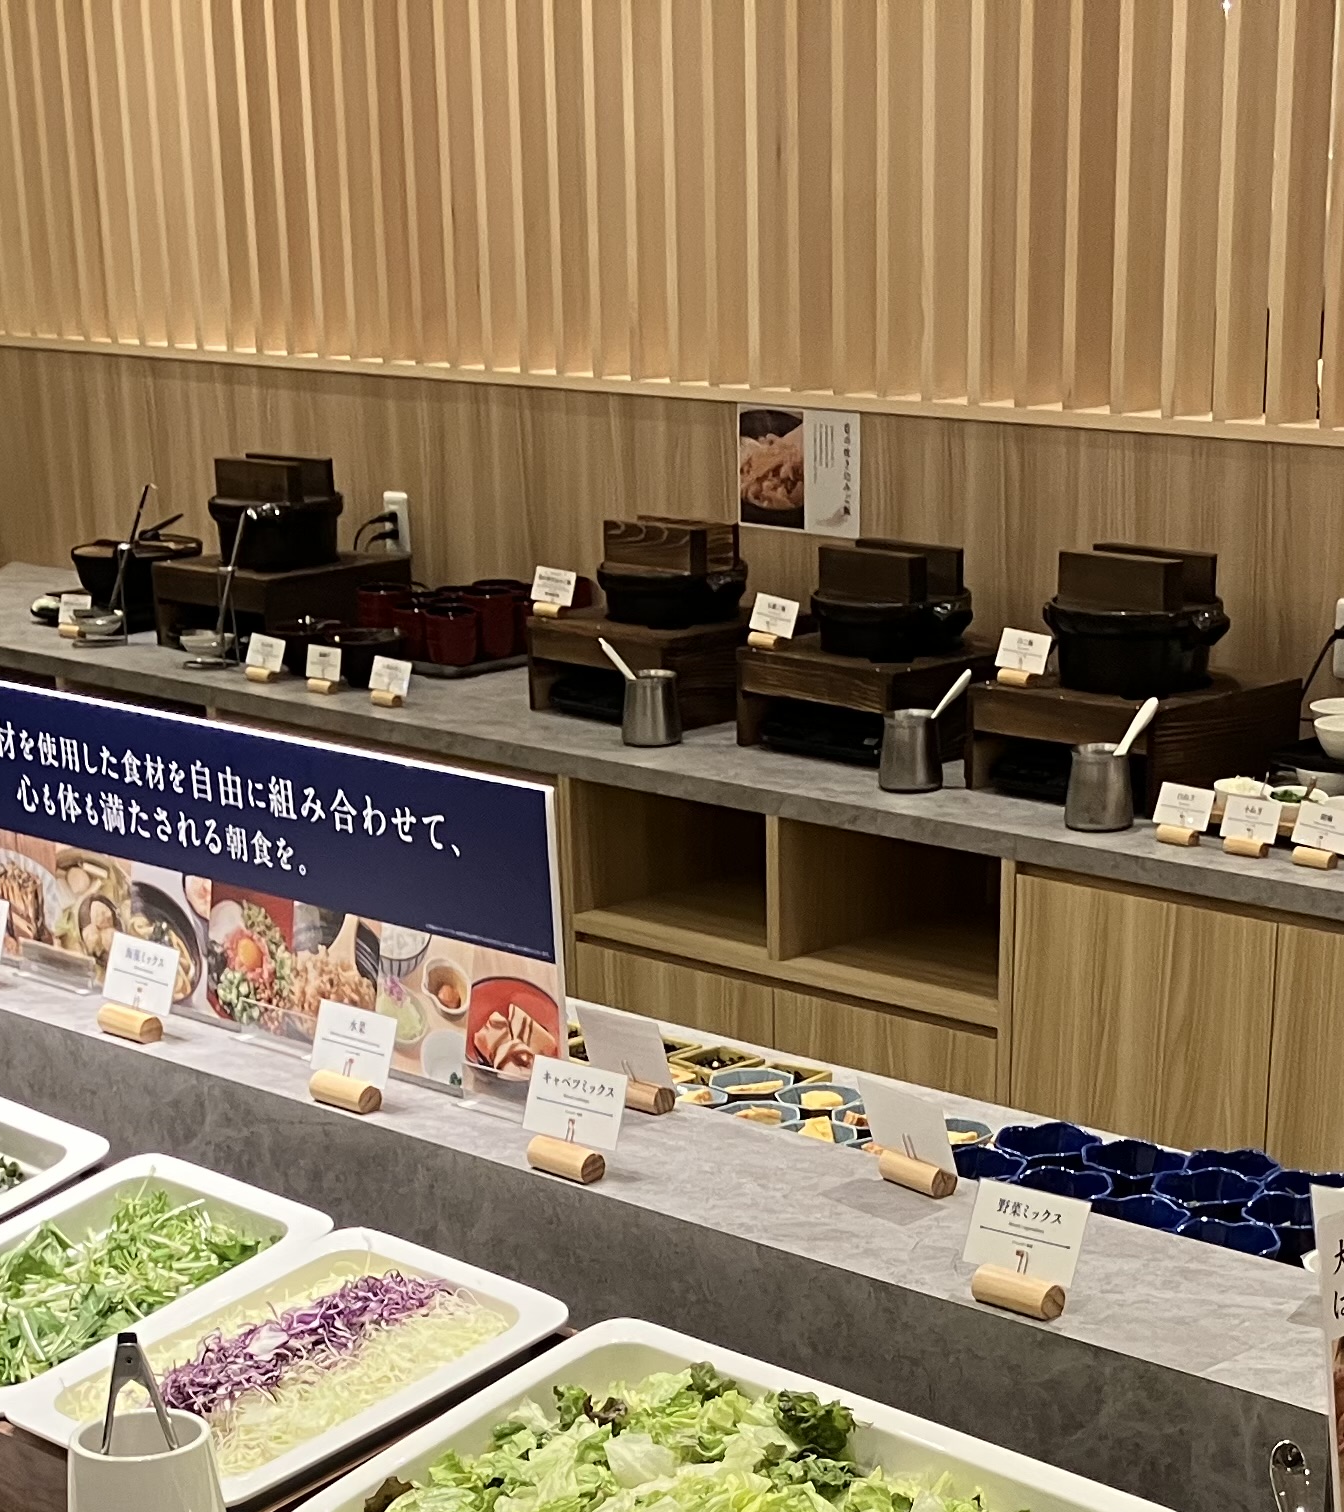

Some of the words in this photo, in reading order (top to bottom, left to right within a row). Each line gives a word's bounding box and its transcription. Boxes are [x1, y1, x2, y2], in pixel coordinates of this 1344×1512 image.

[16, 773, 307, 877] 心も体も満たされる朝食を。
[542, 1069, 615, 1098] キャベツミックス
[996, 1197, 1063, 1225] 野菜ミックス
